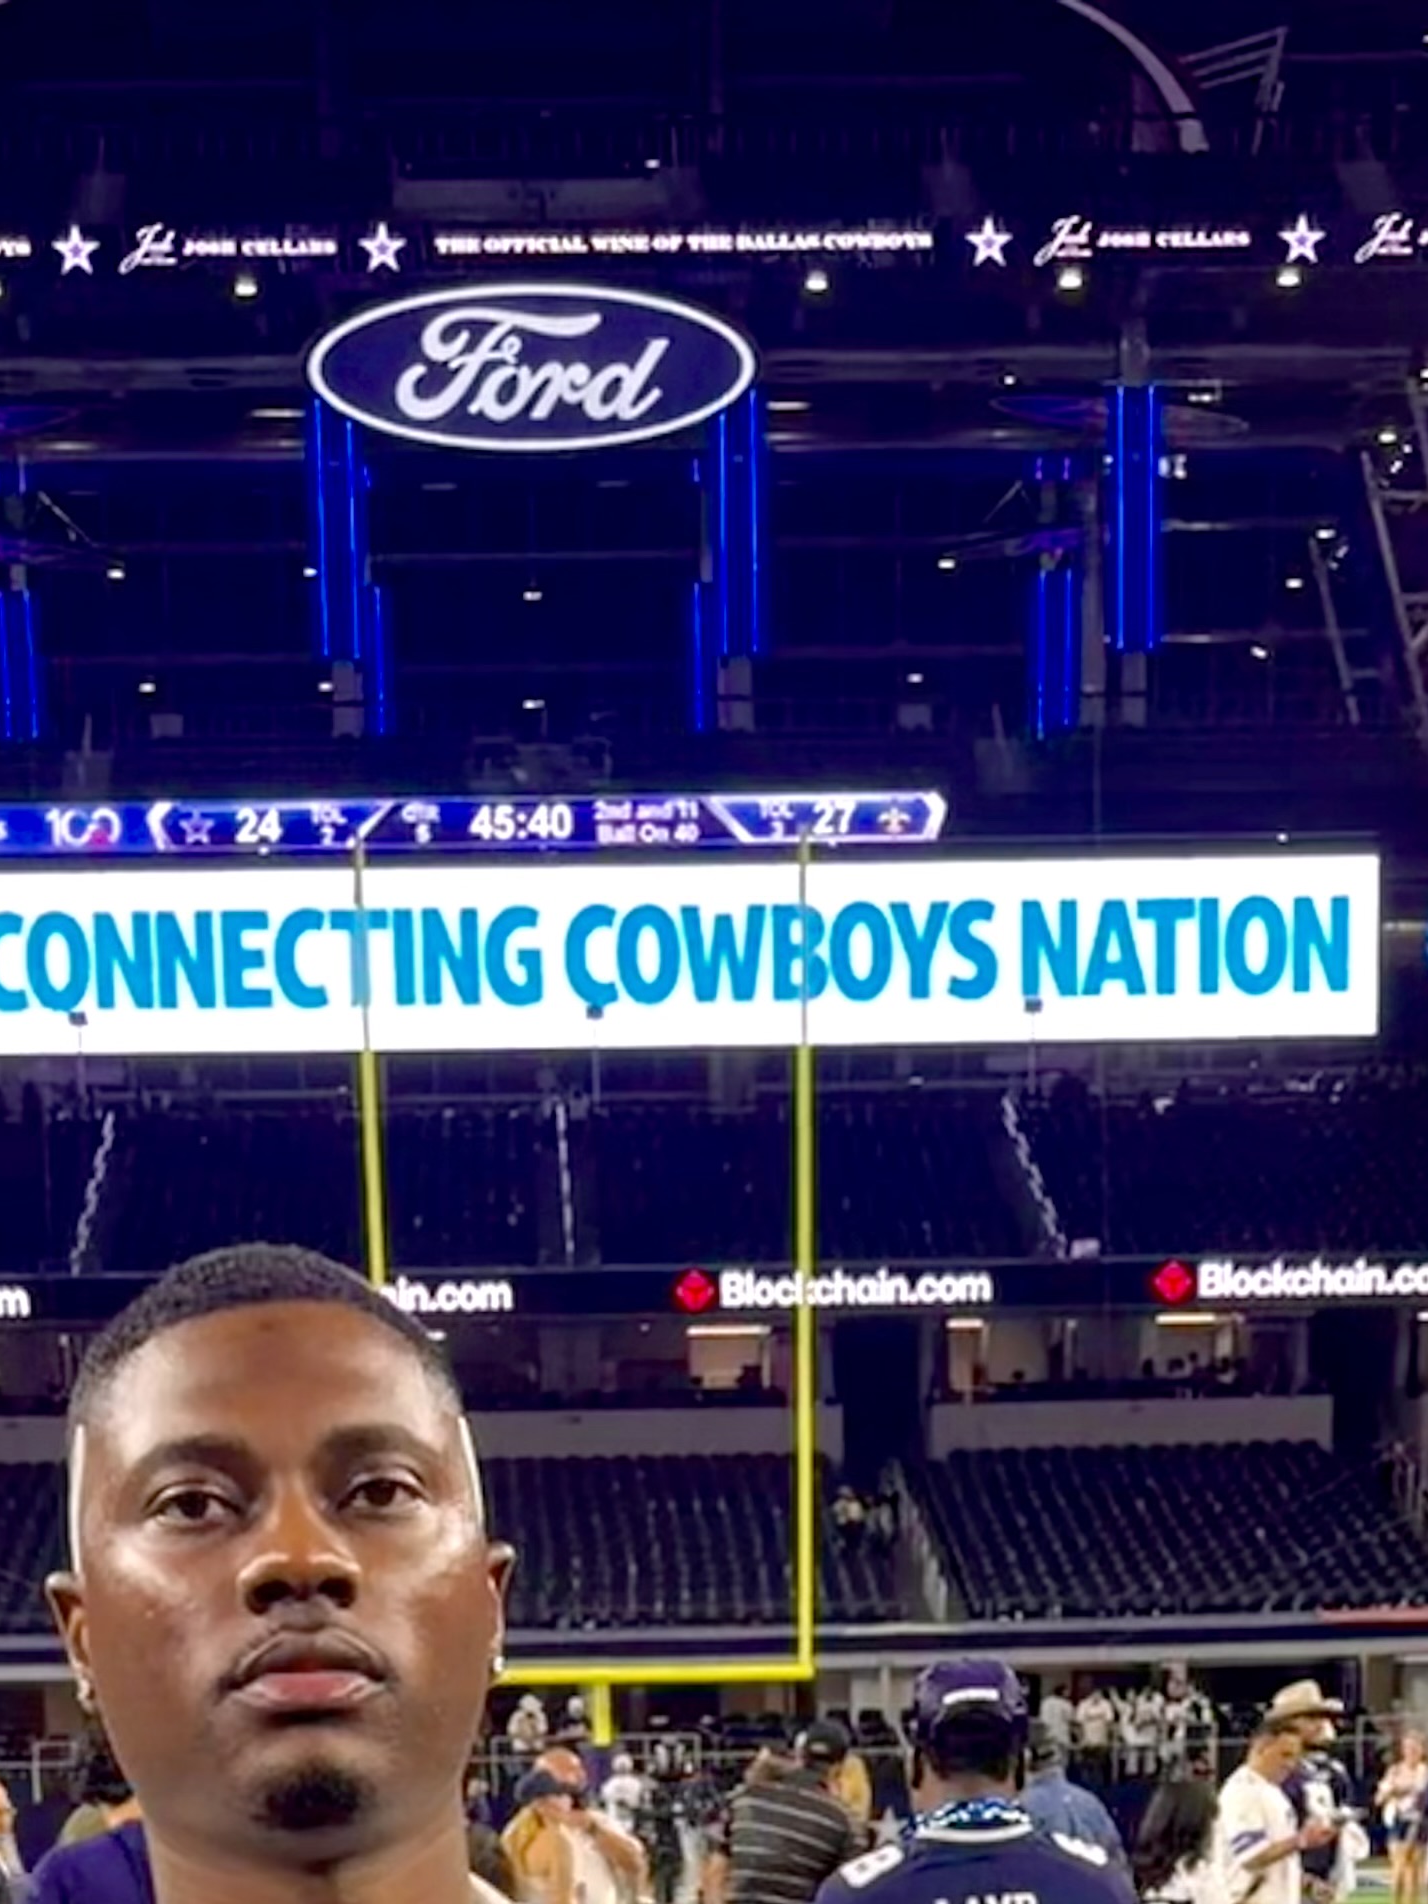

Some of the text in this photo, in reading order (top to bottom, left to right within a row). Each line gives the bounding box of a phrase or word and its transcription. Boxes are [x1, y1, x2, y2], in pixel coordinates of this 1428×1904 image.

[182, 239, 237, 257] JOSH
[241, 239, 339, 257] CELLARS
[434, 235, 480, 255] THE
[483, 235, 588, 254] OFFICIAL
[652, 234, 683, 253] OF
[686, 234, 732, 252] THE
[1097, 231, 1151, 248] JOSH
[1155, 231, 1252, 248] CELLARS
[395, 307, 670, 422] Ford
[235, 807, 284, 844] 24
[470, 804, 572, 841] 45:40
[638, 823, 670, 843] On
[813, 800, 856, 834] 27
[565, 900, 999, 1006] COWBOYS
[1020, 895, 1350, 998] NATION
[719, 1268, 993, 1308] Blockchain.com
